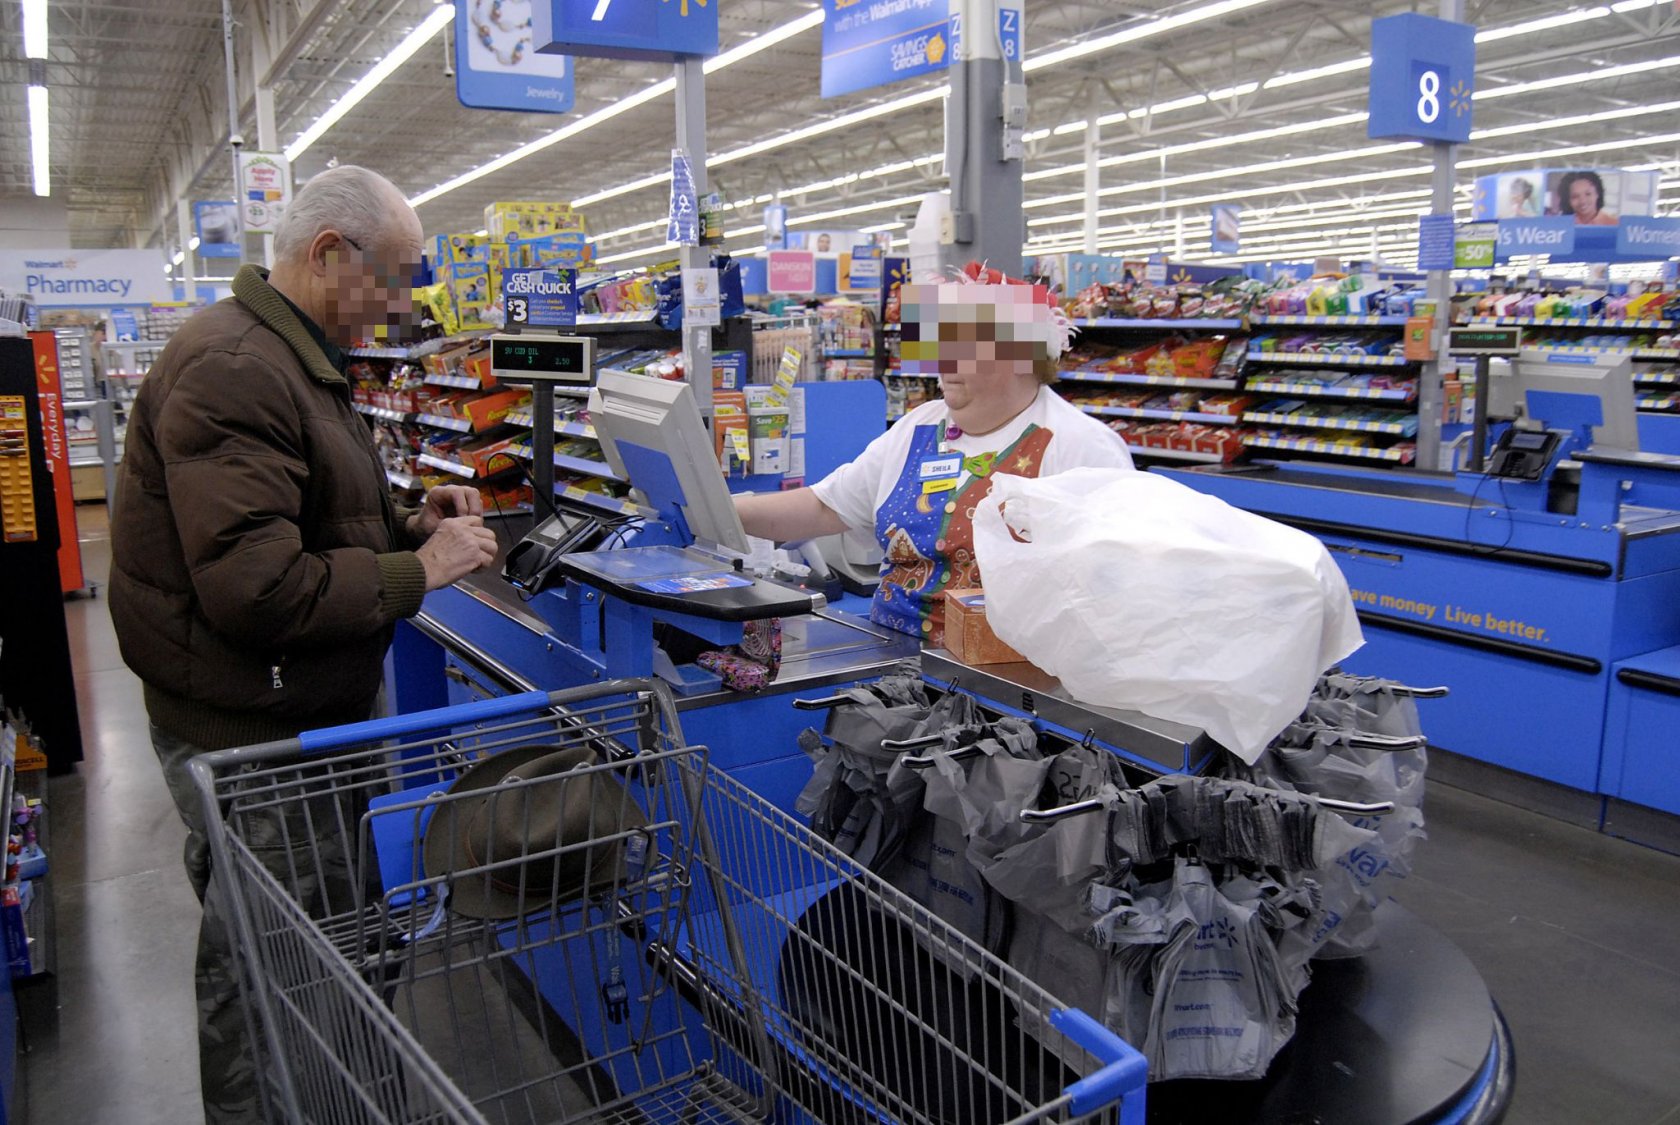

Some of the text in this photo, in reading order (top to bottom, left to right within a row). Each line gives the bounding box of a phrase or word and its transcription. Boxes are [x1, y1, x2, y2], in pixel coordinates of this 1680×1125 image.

[853, 11, 870, 27] the
[870, 0, 912, 21] Walmart
[1003, 11, 1016, 32] Z
[890, 35, 929, 61] SAVINGS
[1004, 39, 1015, 57] 8
[526, 86, 566, 102] Jewelry
[1416, 70, 1440, 124] 8
[1516, 227, 1567, 244] Wear
[25, 260, 64, 268] Walmart
[26, 274, 132, 297] Pharmacy
[507, 282, 571, 295] CASH QUICK
[512, 273, 530, 285] GET
[507, 299, 528, 322] $3
[46, 393, 62, 459] Everyday
[756, 416, 772, 425] Save
[1350, 589, 1551, 643] ave money Live better.
